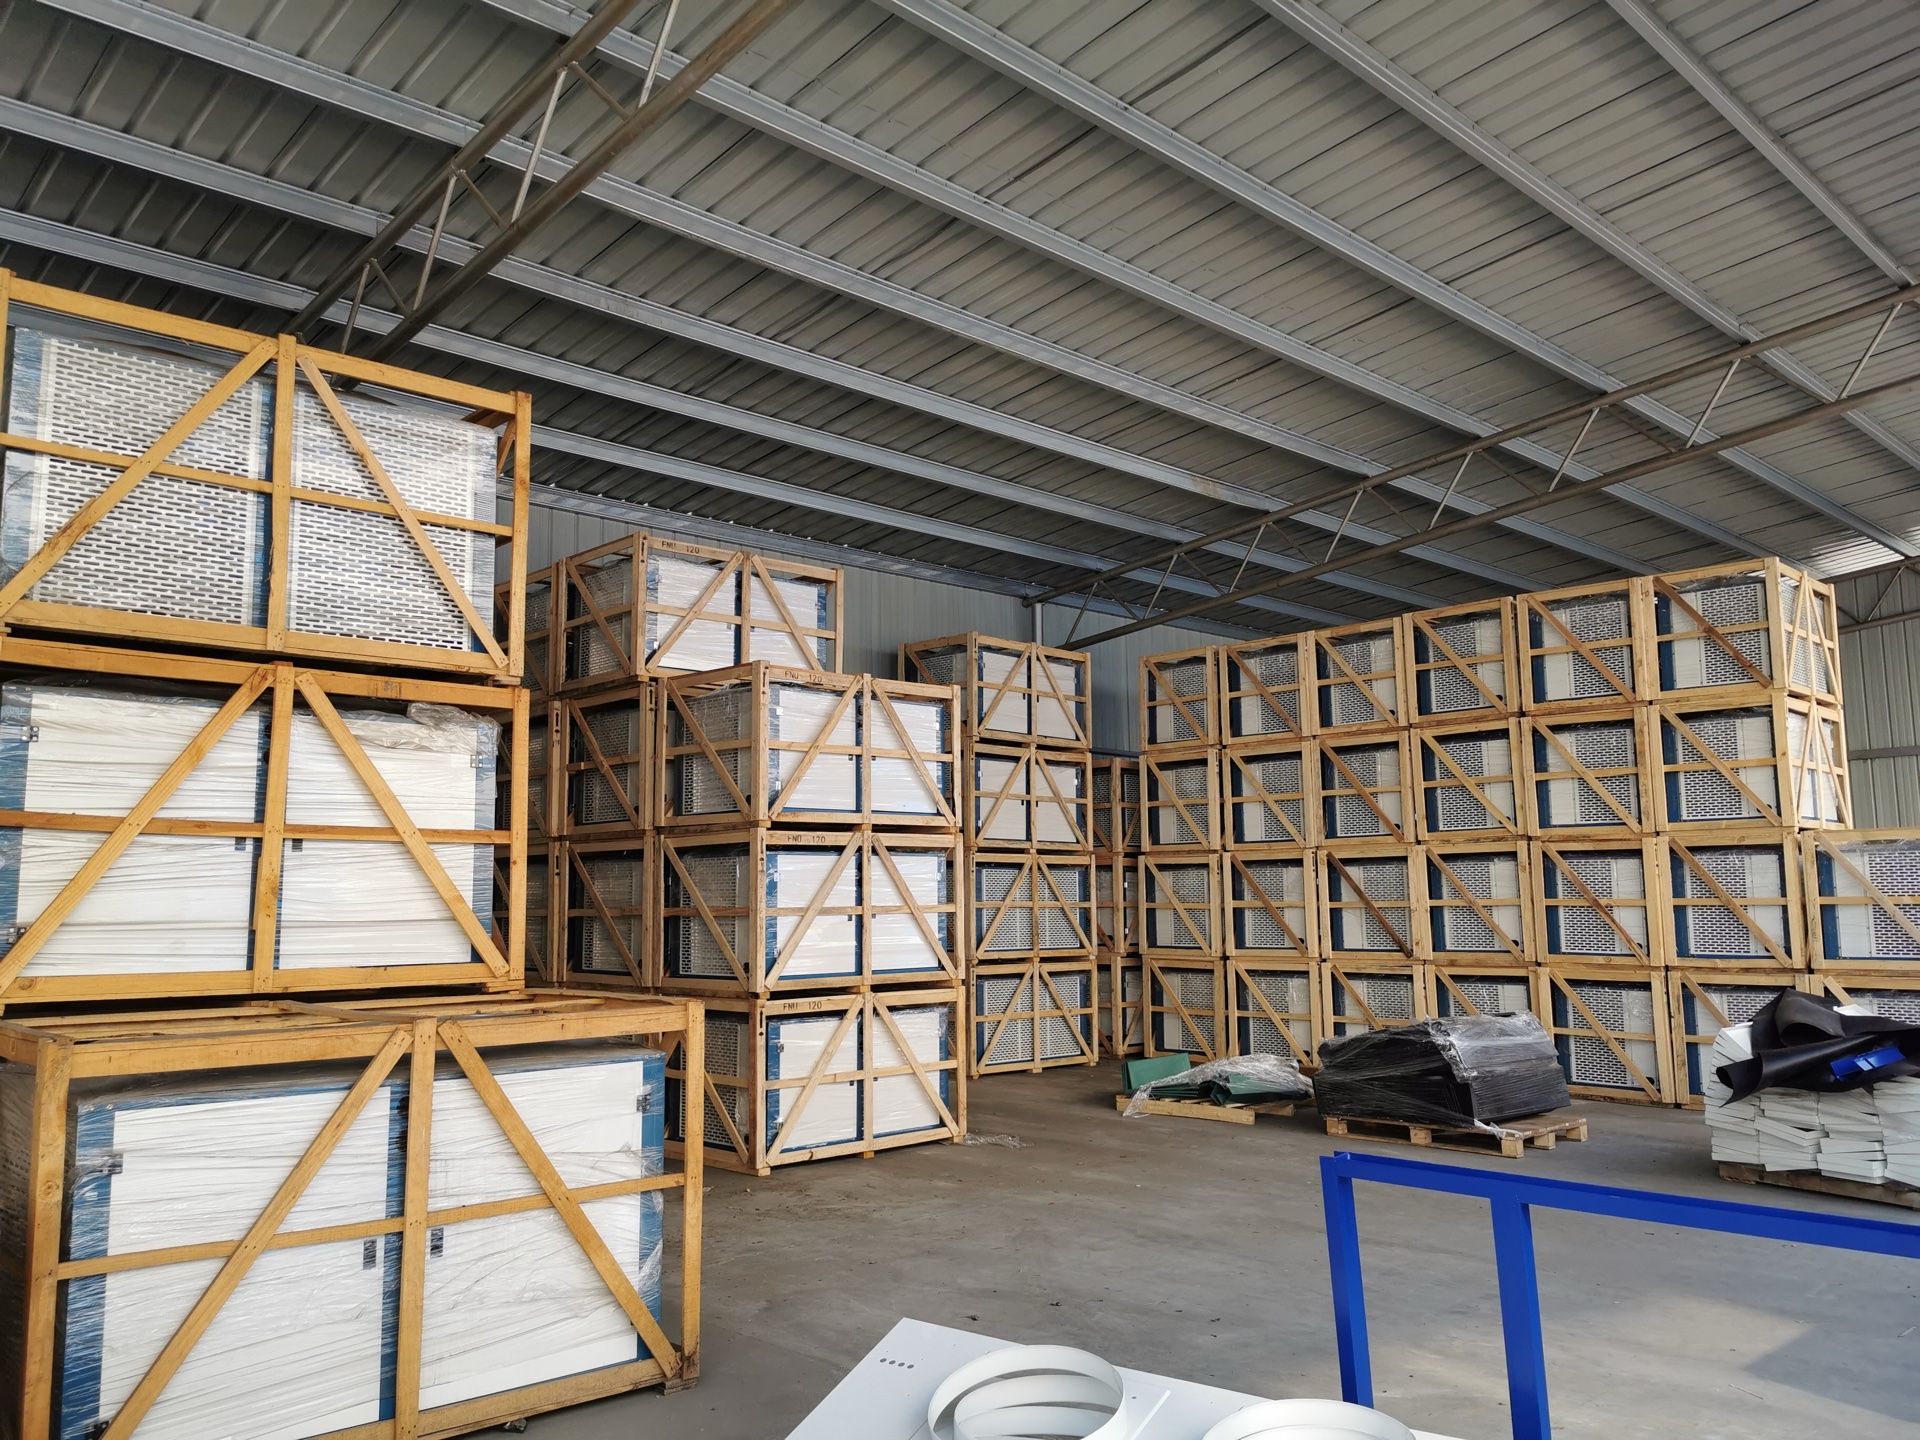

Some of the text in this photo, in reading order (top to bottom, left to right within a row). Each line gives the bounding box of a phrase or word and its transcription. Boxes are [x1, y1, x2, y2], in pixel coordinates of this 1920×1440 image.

[685, 545, 700, 555] 120
[808, 674, 823, 683] 120
[811, 835, 826, 844] 120
[808, 1000, 823, 1010] 120
